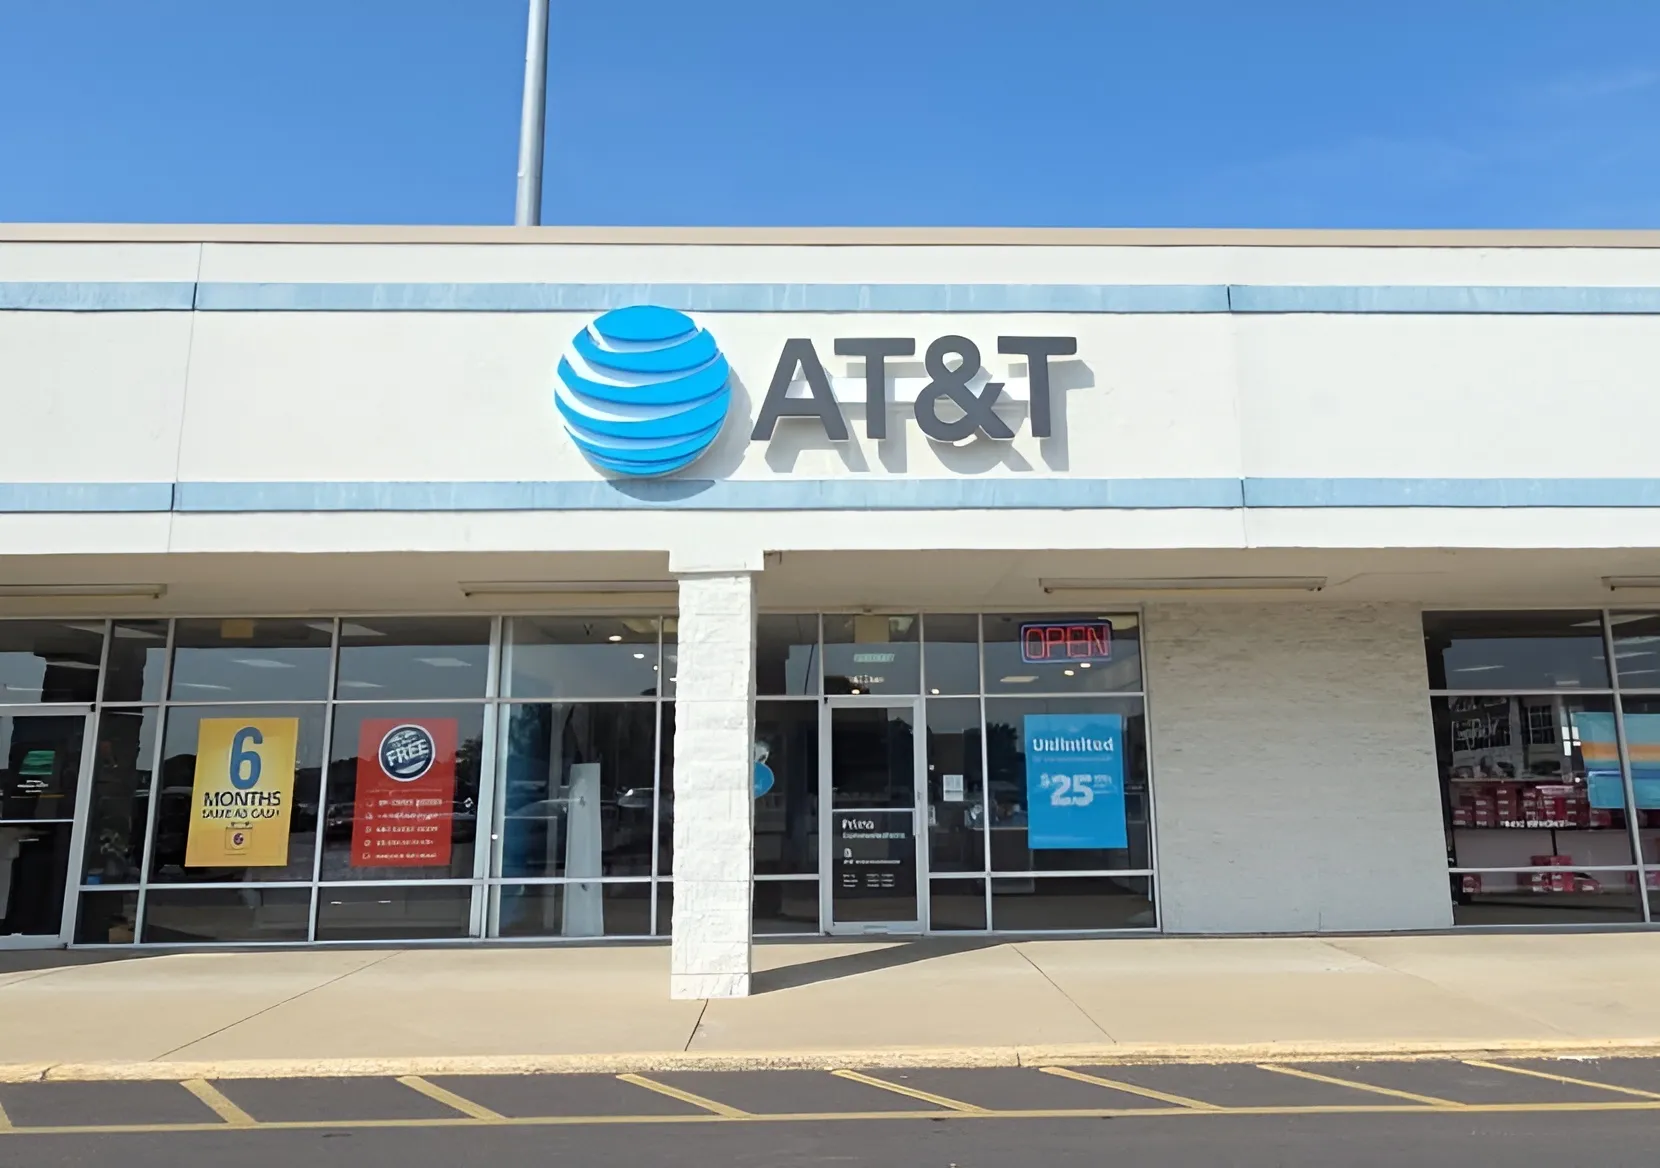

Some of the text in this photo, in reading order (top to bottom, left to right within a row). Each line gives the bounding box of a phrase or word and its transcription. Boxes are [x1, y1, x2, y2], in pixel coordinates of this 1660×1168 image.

[751, 334, 1077, 441] AT&T
[1025, 625, 1109, 659] OPEN
[229, 726, 264, 791] 6
[385, 738, 430, 767] FREE
[204, 790, 281, 807] MONTHS
